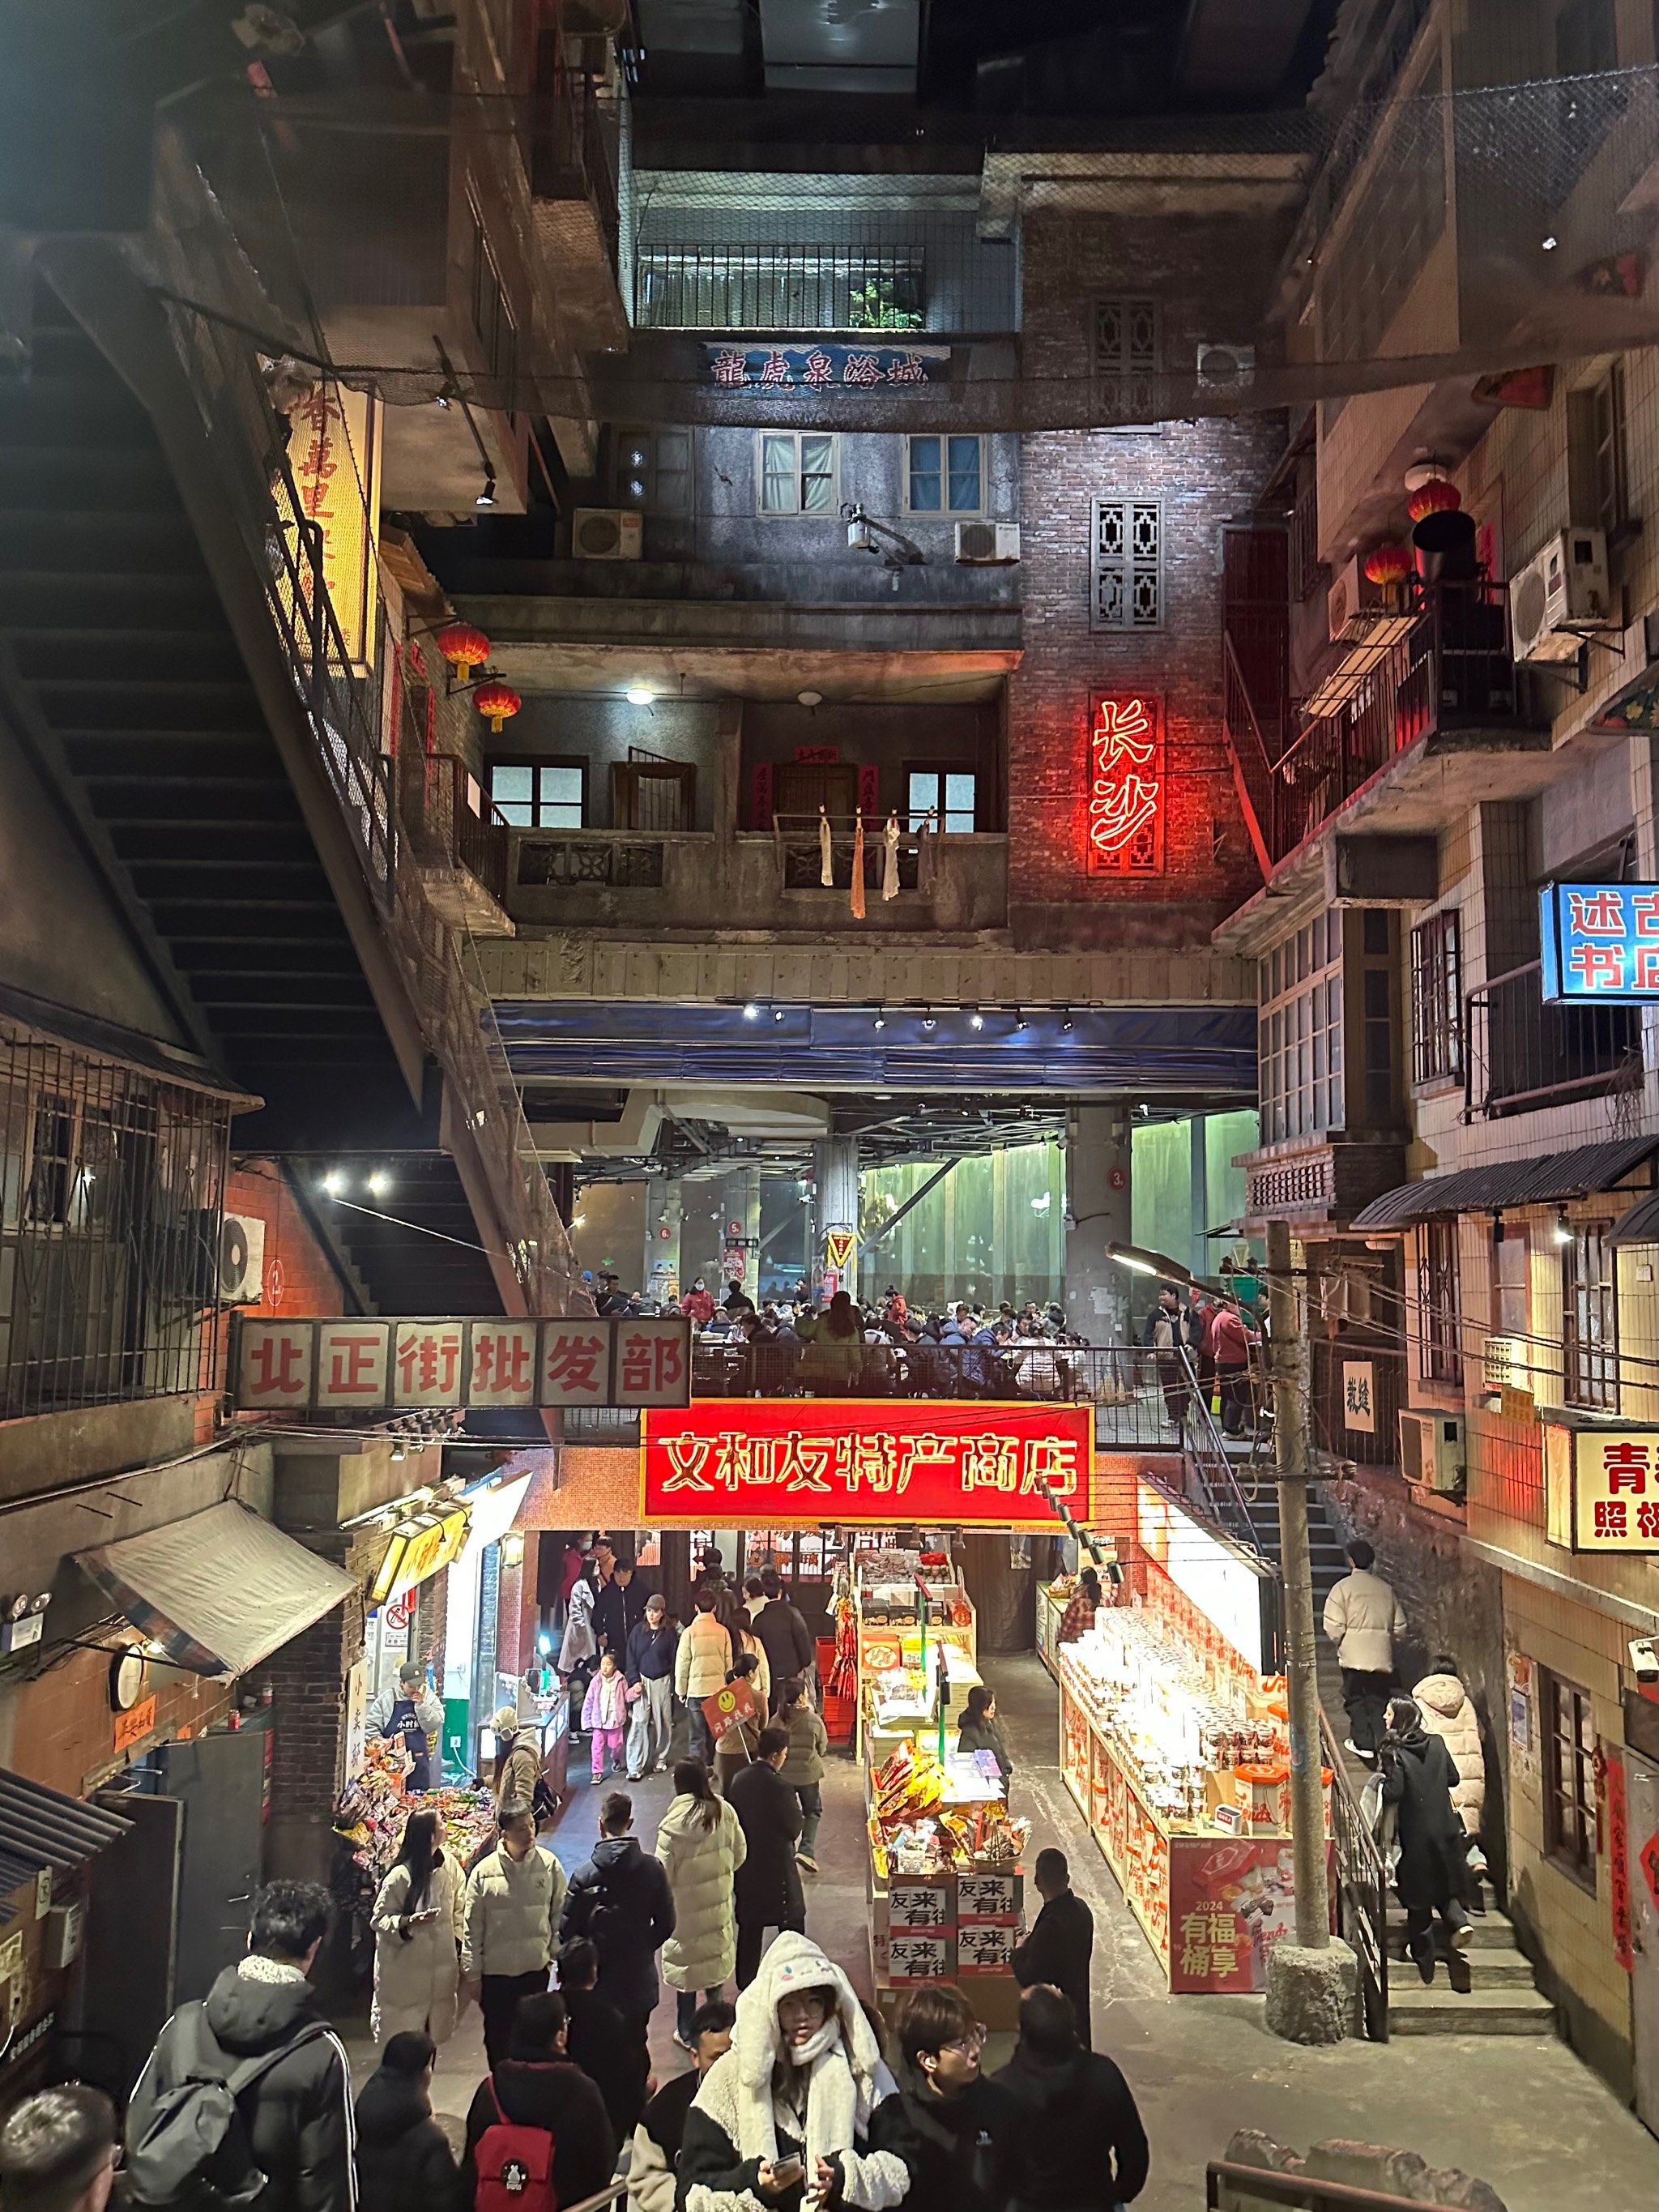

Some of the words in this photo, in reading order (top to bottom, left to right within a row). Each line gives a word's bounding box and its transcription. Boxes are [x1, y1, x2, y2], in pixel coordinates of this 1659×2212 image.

[1090, 698, 1159, 852] 长沙
[249, 1332, 683, 1395] 北正街批发部
[658, 1429, 1079, 1494] 文和友特产商店
[1603, 1442, 1659, 1495] 青
[890, 1891, 937, 1909] 友来
[959, 1879, 1005, 1897] 友来
[1196, 1901, 1223, 1912] 2024
[959, 1930, 1005, 1948] 友来
[1179, 1911, 1236, 1944] 有福
[890, 1941, 937, 1960] 友来
[1179, 1943, 1239, 1979] 桶享
